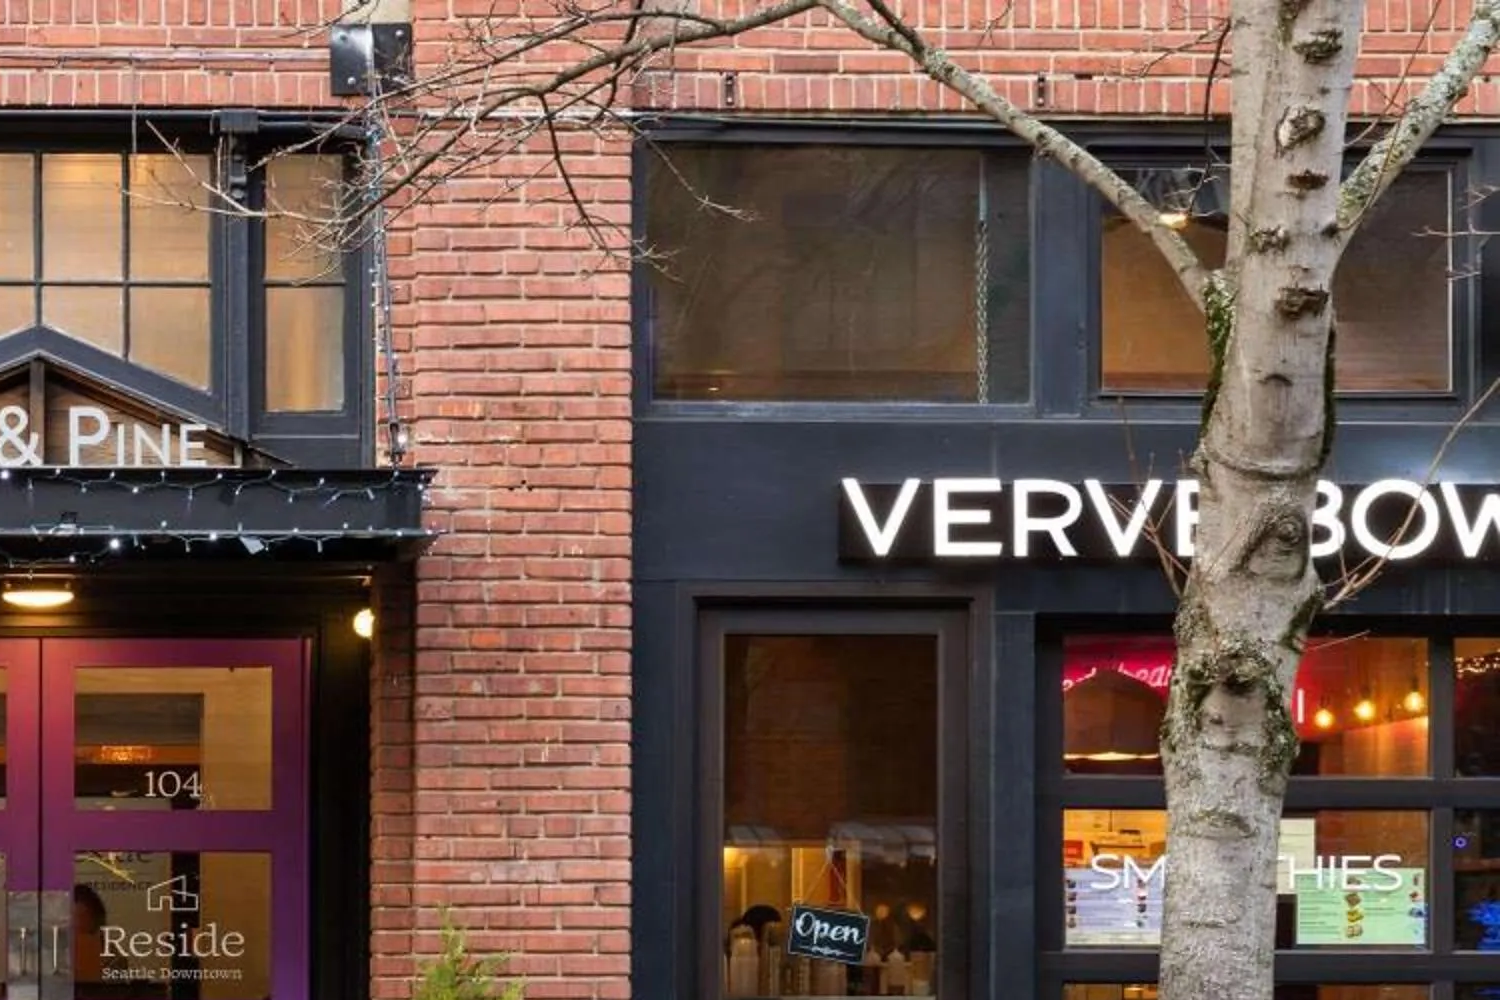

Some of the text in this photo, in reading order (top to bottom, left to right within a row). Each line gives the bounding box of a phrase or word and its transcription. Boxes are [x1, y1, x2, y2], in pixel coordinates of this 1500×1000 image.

[144, 770, 203, 798] 104
[1090, 852, 1404, 891] SMHIES
[99, 922, 246, 958] Reside
[795, 911, 867, 945] Open
[101, 966, 243, 980] Seattle Downtown
